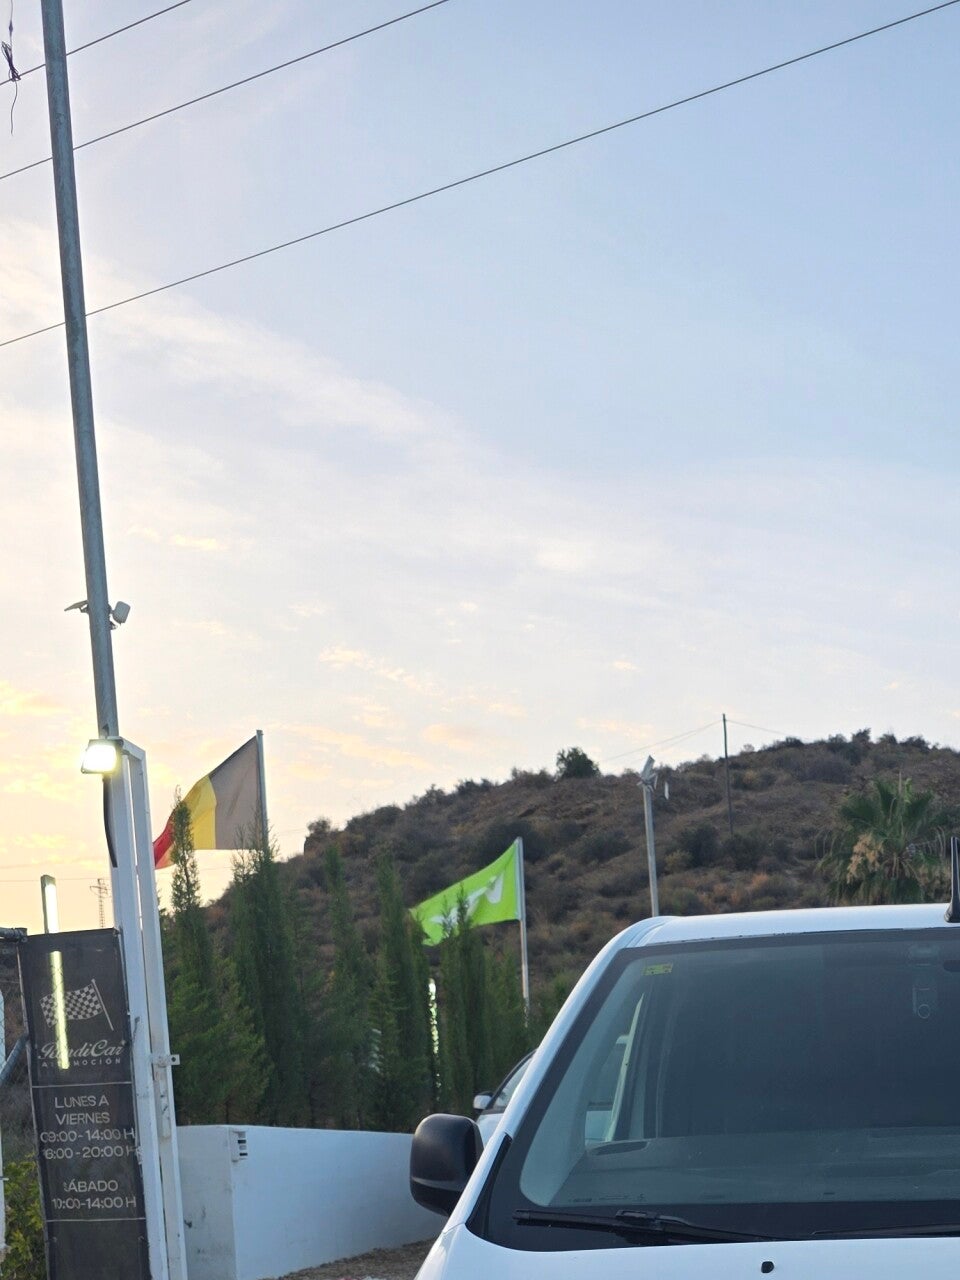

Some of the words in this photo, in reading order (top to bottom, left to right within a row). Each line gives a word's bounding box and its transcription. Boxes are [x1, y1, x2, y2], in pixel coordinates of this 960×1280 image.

[54, 1095, 97, 1108] LUNES
[98, 1094, 110, 1106] A
[55, 1111, 111, 1125] VIERNES
[125, 1195, 137, 1208] H
